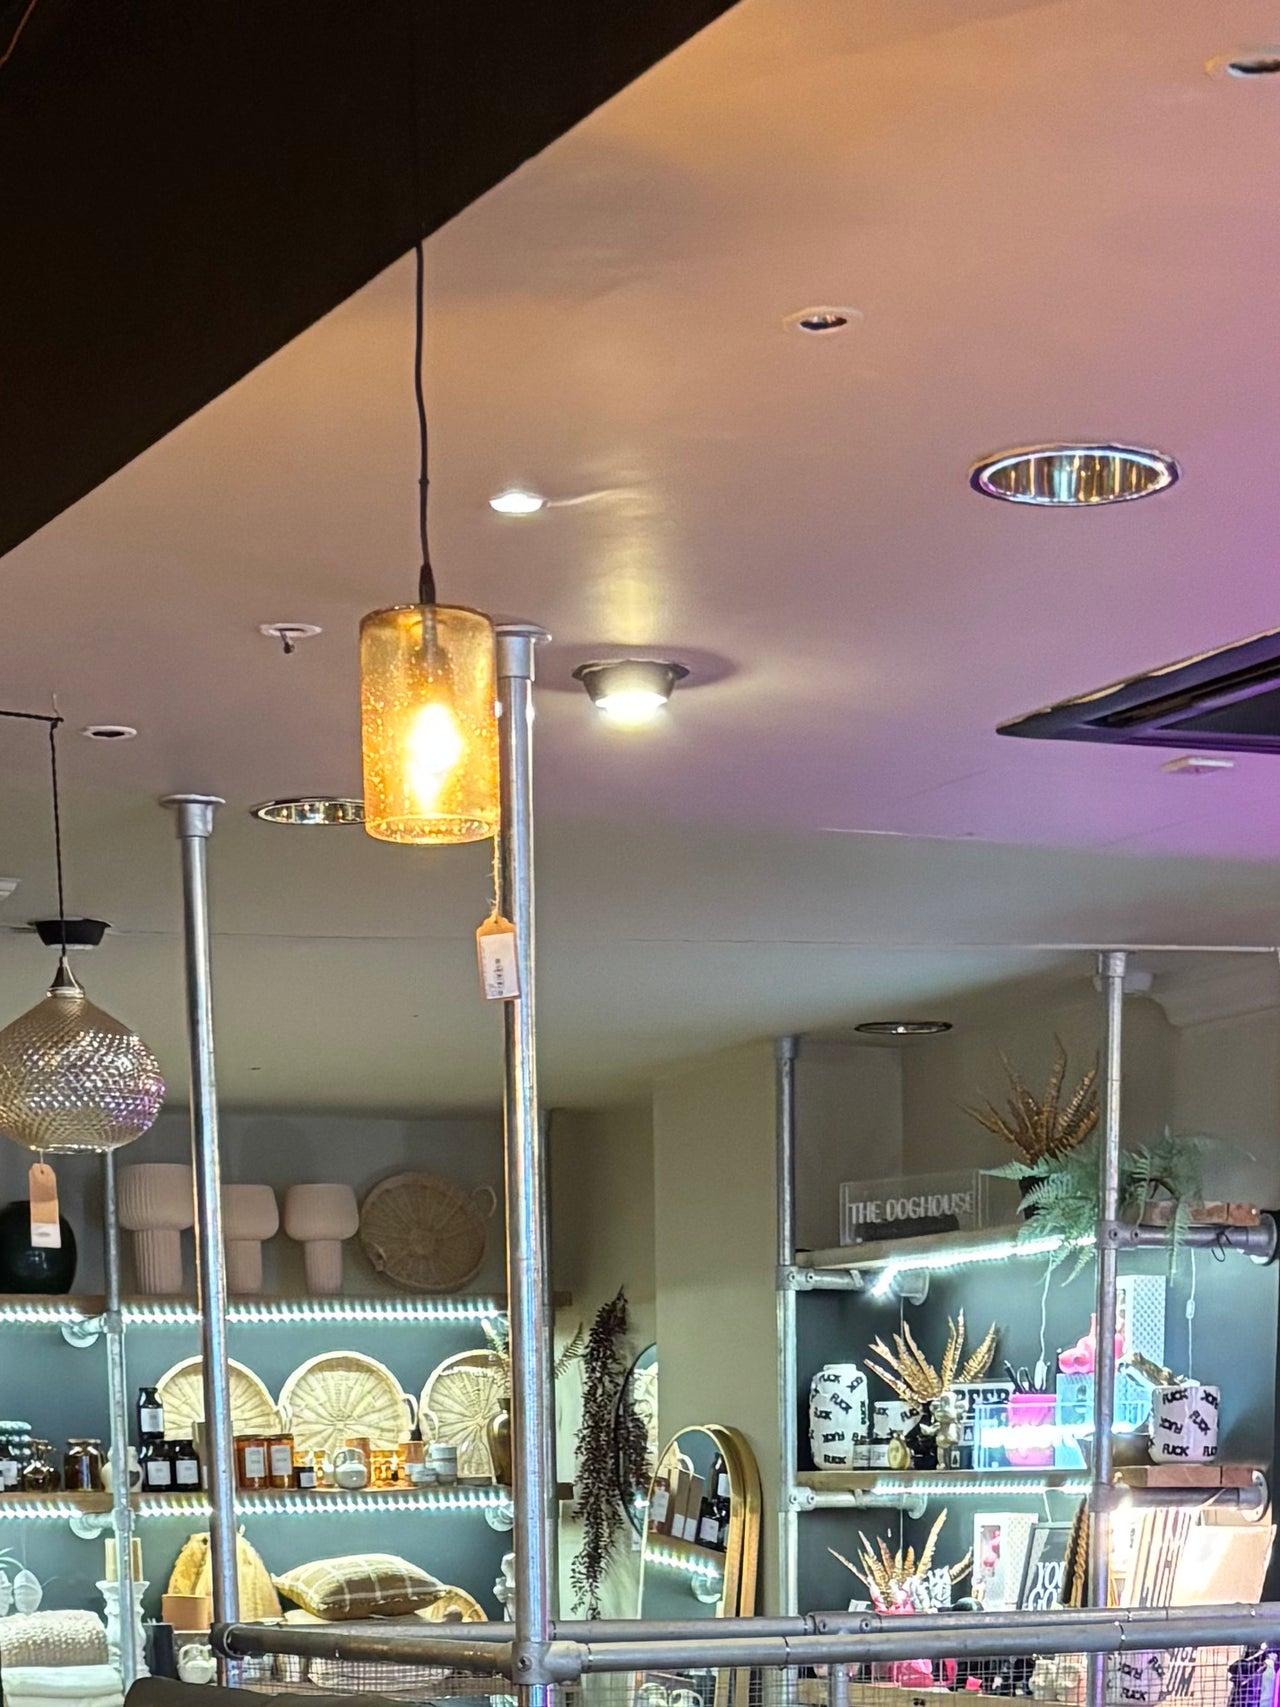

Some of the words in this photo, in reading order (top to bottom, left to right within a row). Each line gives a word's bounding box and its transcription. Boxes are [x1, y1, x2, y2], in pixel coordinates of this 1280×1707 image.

[849, 1201, 881, 1224] THE
[886, 1193, 974, 1221] DOGHOUSE
[829, 1392, 852, 1415] FUCK
[1162, 1388, 1188, 1405] FUCK
[1189, 1410, 1211, 1436] FUCK
[1162, 1443, 1189, 1457] FUCK
